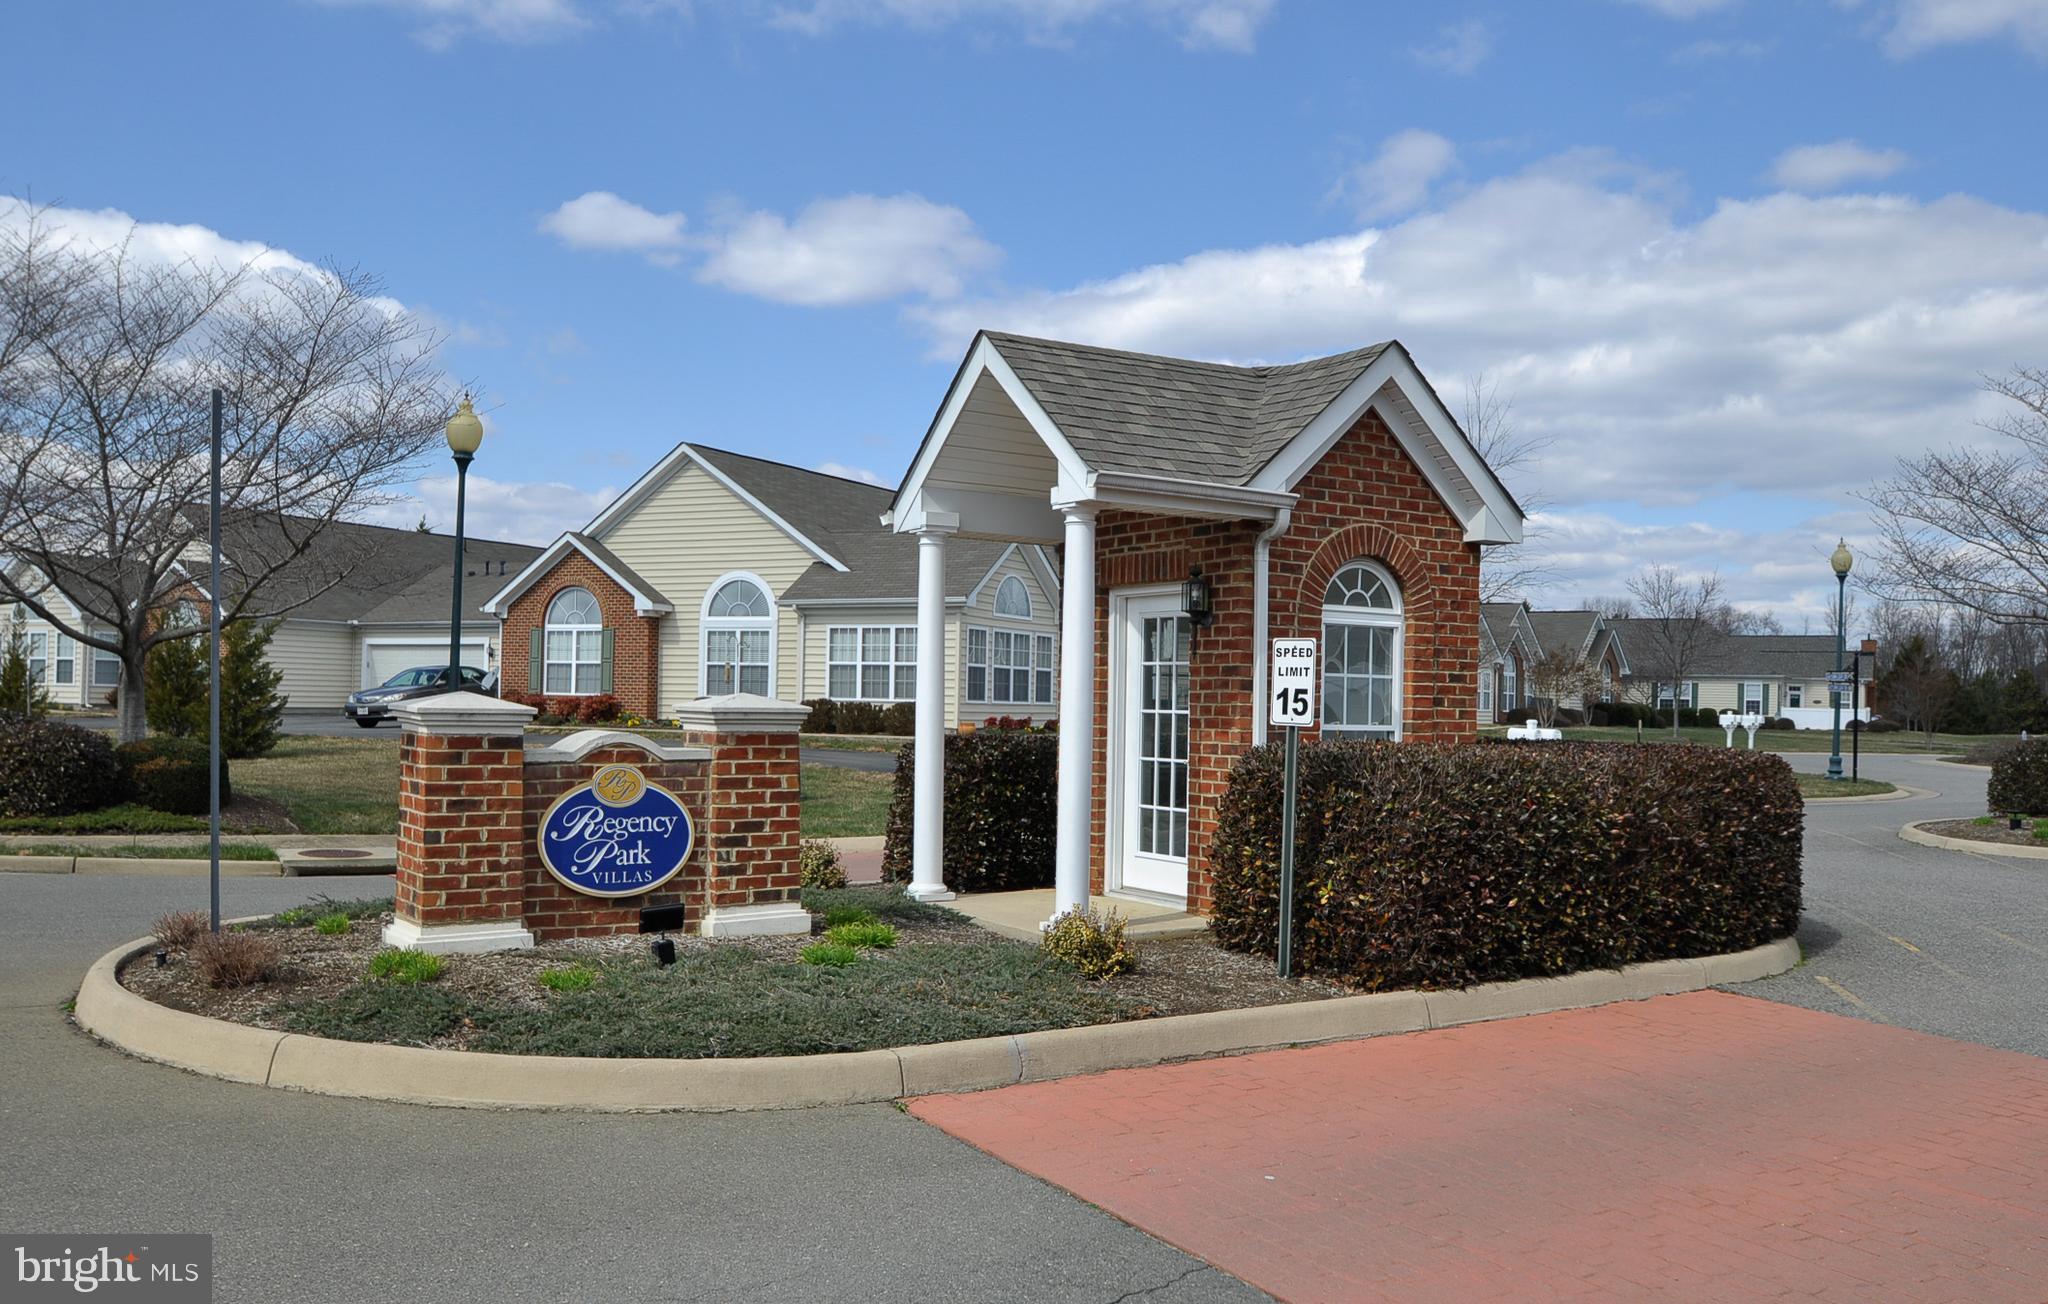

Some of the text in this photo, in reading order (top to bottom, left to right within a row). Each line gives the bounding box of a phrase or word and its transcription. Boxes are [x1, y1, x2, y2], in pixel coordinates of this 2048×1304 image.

[1275, 647, 1313, 658] SPEED
[1278, 666, 1311, 677] LIMIT
[1276, 687, 1309, 717] 15
[550, 805, 679, 842] Regency
[570, 838, 652, 876] Park
[592, 870, 653, 884] VILLAS
